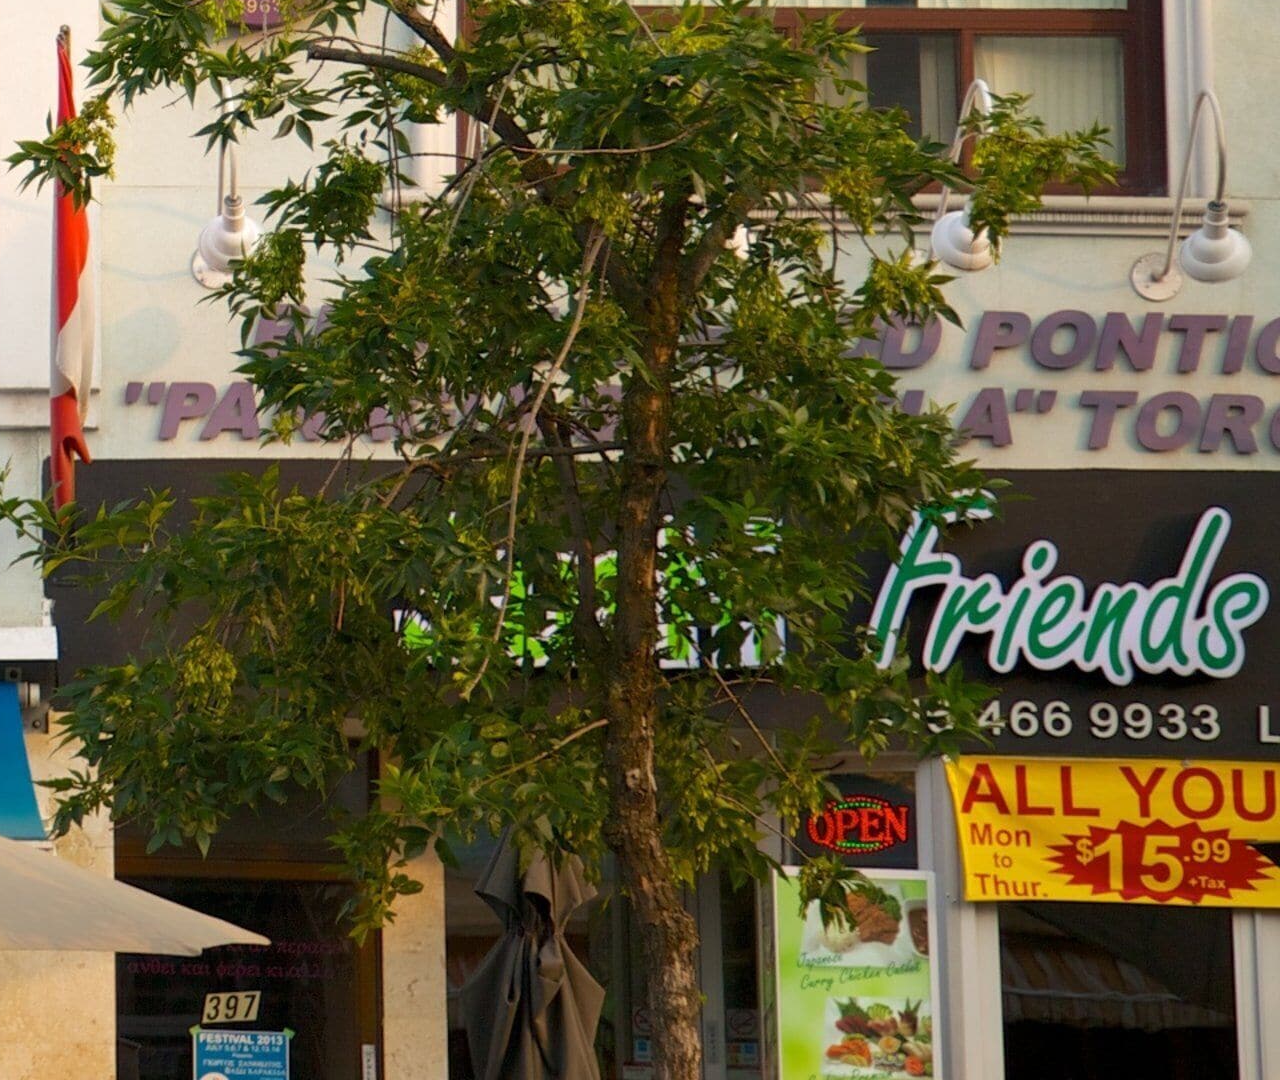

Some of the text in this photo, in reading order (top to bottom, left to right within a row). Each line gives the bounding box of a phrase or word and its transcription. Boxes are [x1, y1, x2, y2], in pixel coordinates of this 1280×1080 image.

[1081, 389, 1280, 455] TOR
[868, 488, 1269, 686] Friends
[1088, 702, 1222, 741] 9933
[961, 763, 1277, 822] ALL YOU
[807, 804, 909, 844] OPEN
[970, 823, 1032, 848] Mon
[993, 851, 1013, 869] to
[974, 872, 1049, 898] Thur.
[1189, 876, 1227, 890] +Tax
[206, 994, 257, 1020] 397
[200, 1033, 283, 1046] FESTIVAL 2013
